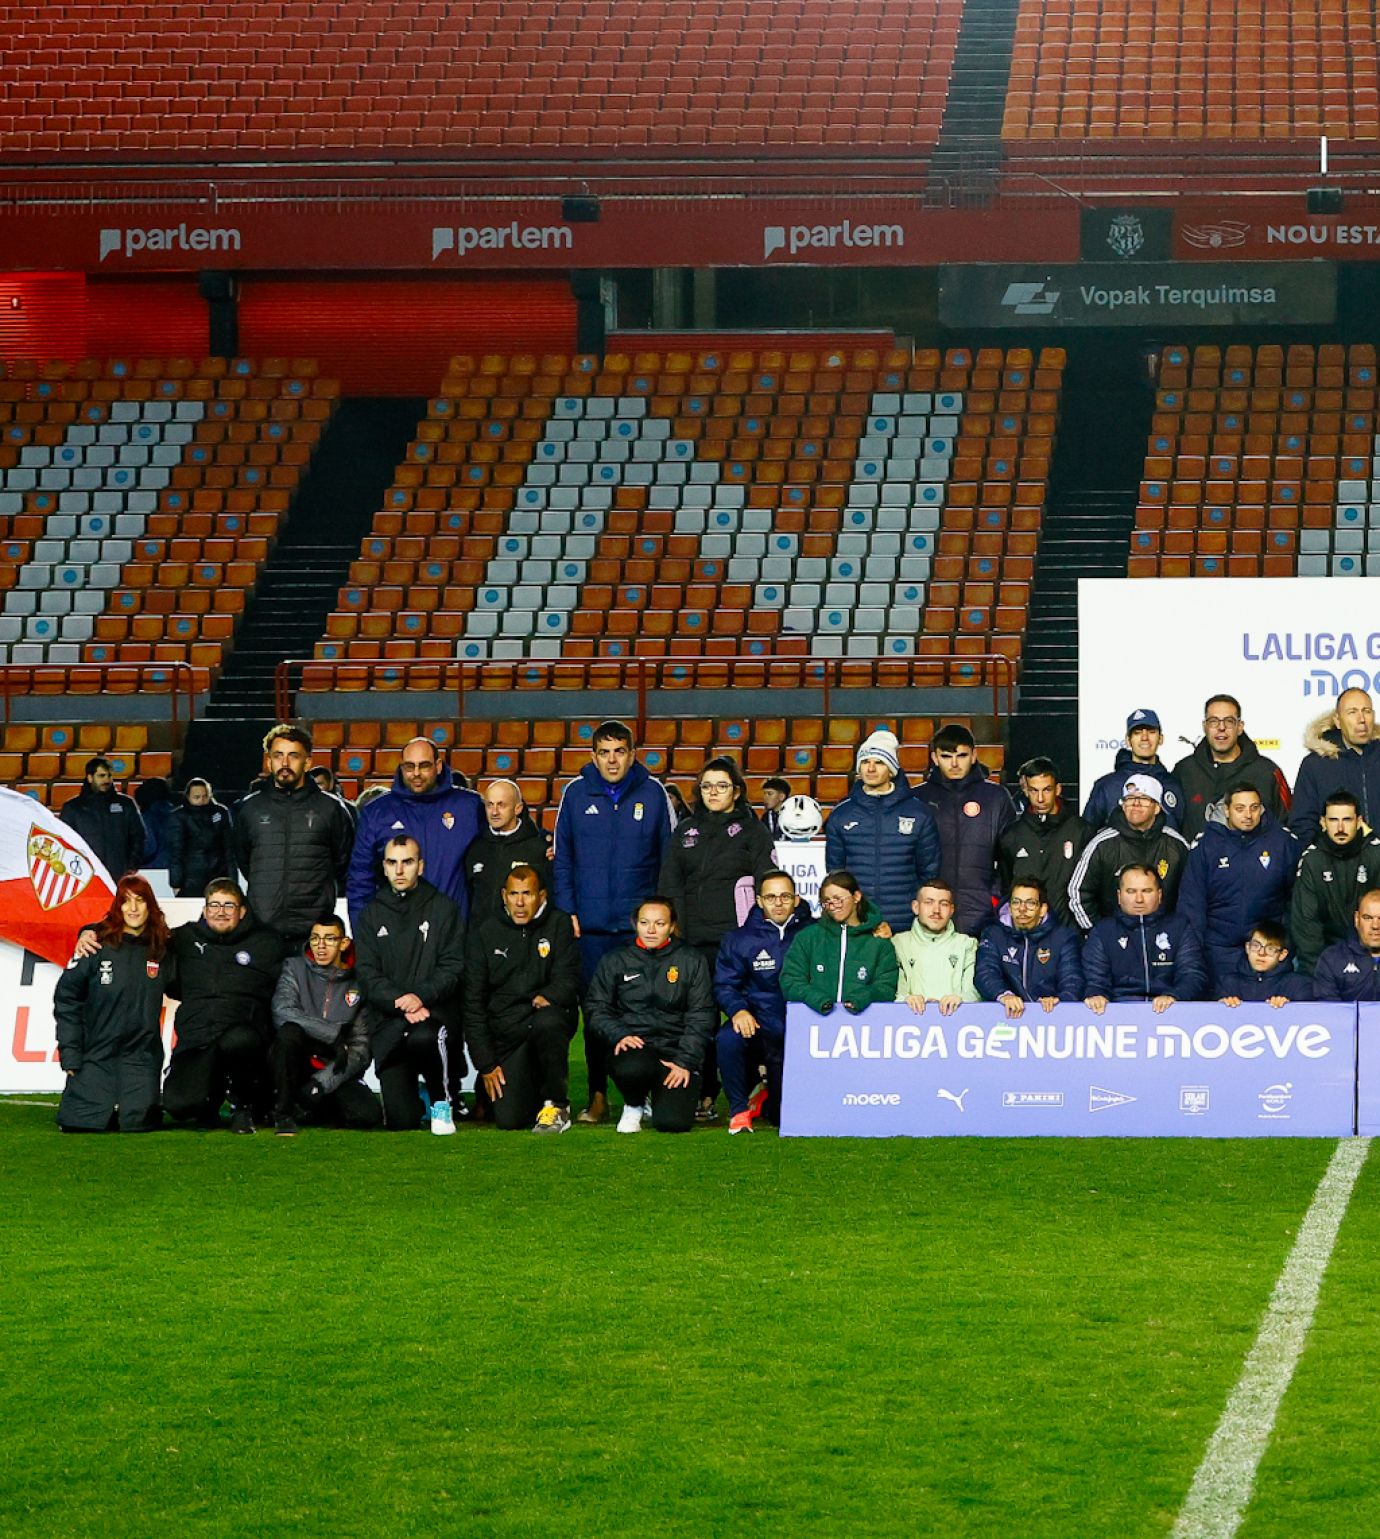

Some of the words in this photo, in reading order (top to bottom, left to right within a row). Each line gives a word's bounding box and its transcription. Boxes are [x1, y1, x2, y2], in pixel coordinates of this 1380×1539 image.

[126, 223, 241, 257] parlem
[458, 221, 572, 256] parlem
[790, 220, 904, 254] parlem
[1267, 225, 1327, 244] NOU
[1080, 285, 1150, 310] Vopak
[1155, 285, 1276, 309] Terquimsa
[1243, 633, 1358, 660] LALIGA
[810, 1025, 947, 1059] LALIGA
[957, 1023, 1137, 1059] GENUINE
[1147, 1024, 1331, 1059] moeve
[843, 1093, 901, 1106] moeve
[1020, 1094, 1061, 1102] PANINI
